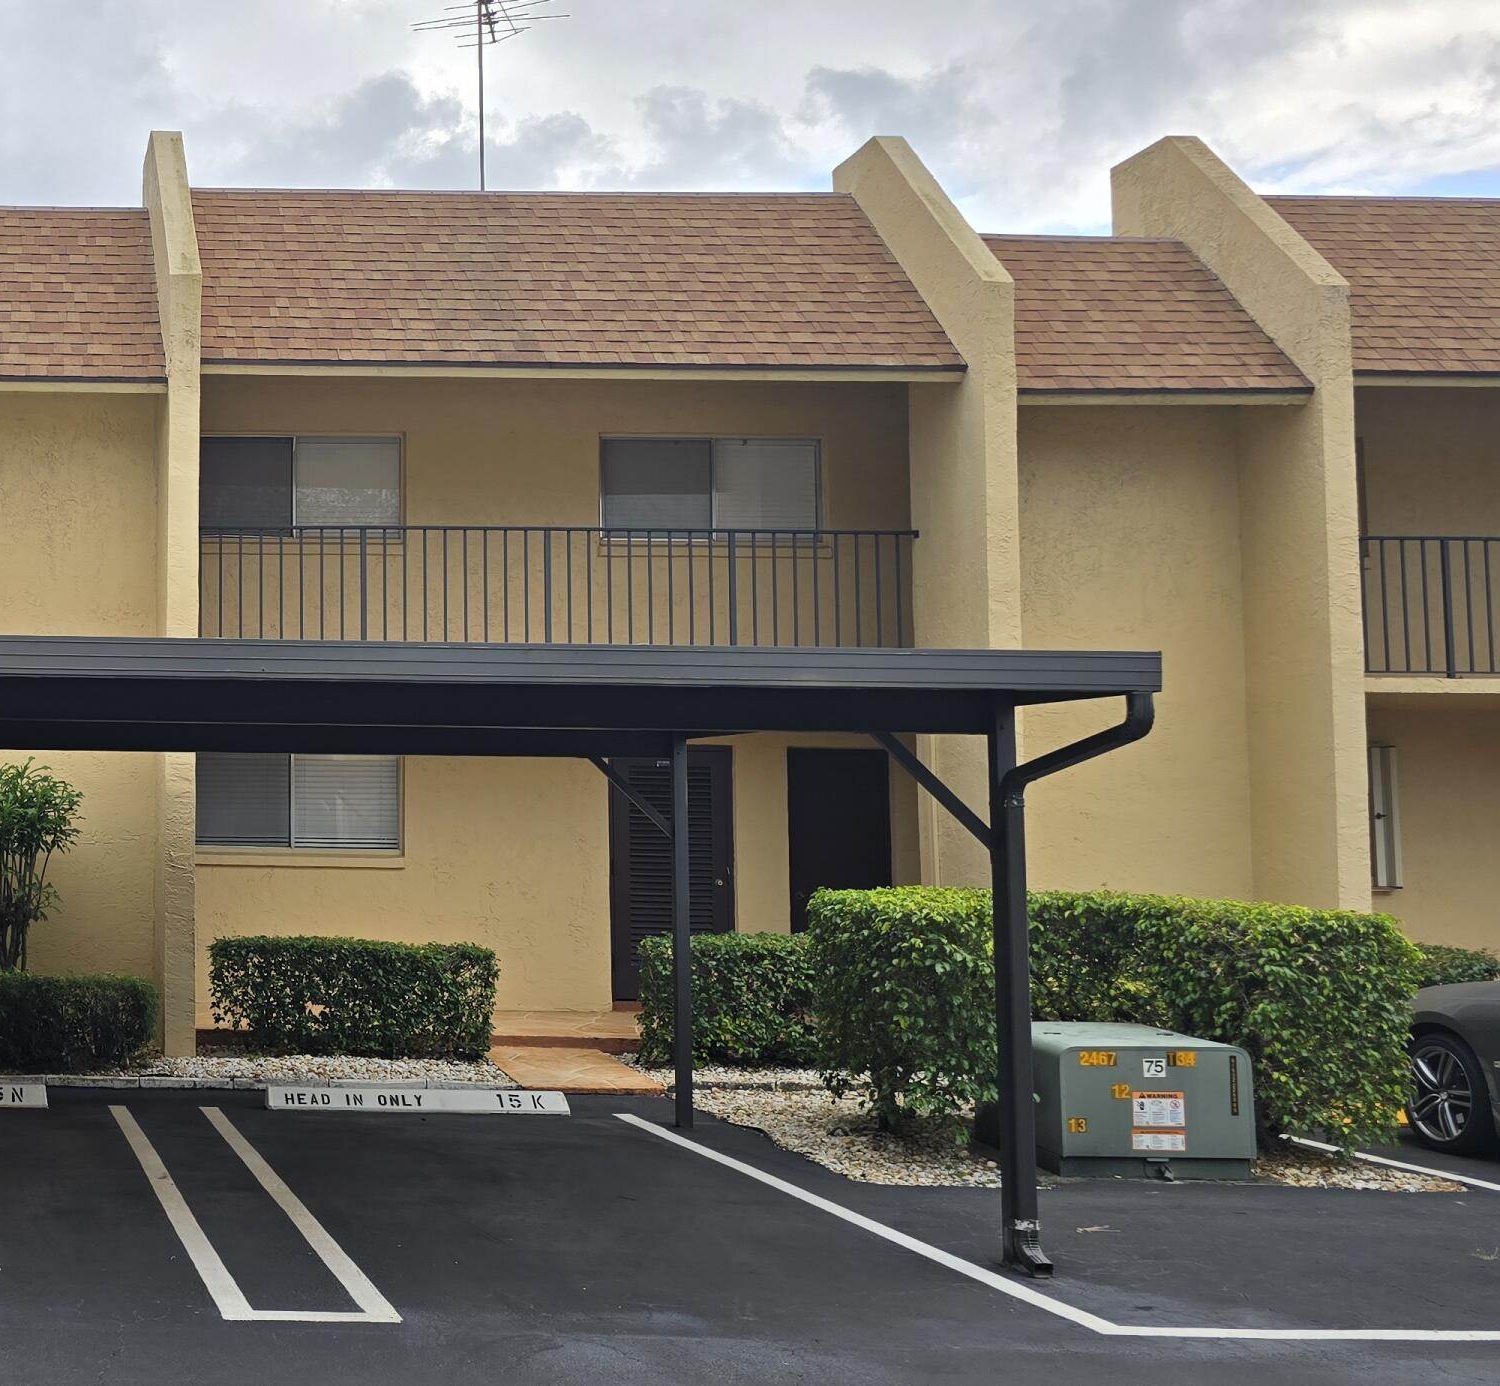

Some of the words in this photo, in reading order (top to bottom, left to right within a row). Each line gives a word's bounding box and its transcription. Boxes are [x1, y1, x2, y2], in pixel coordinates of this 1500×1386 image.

[1079, 1051, 1117, 1066] 2467
[1144, 1060, 1164, 1073] 75
[1112, 1084, 1131, 1099] 12
[284, 1093, 331, 1105] HEAD
[345, 1093, 364, 1106] IN
[377, 1094, 423, 1107] ONLY
[1068, 1118, 1087, 1133] 13
